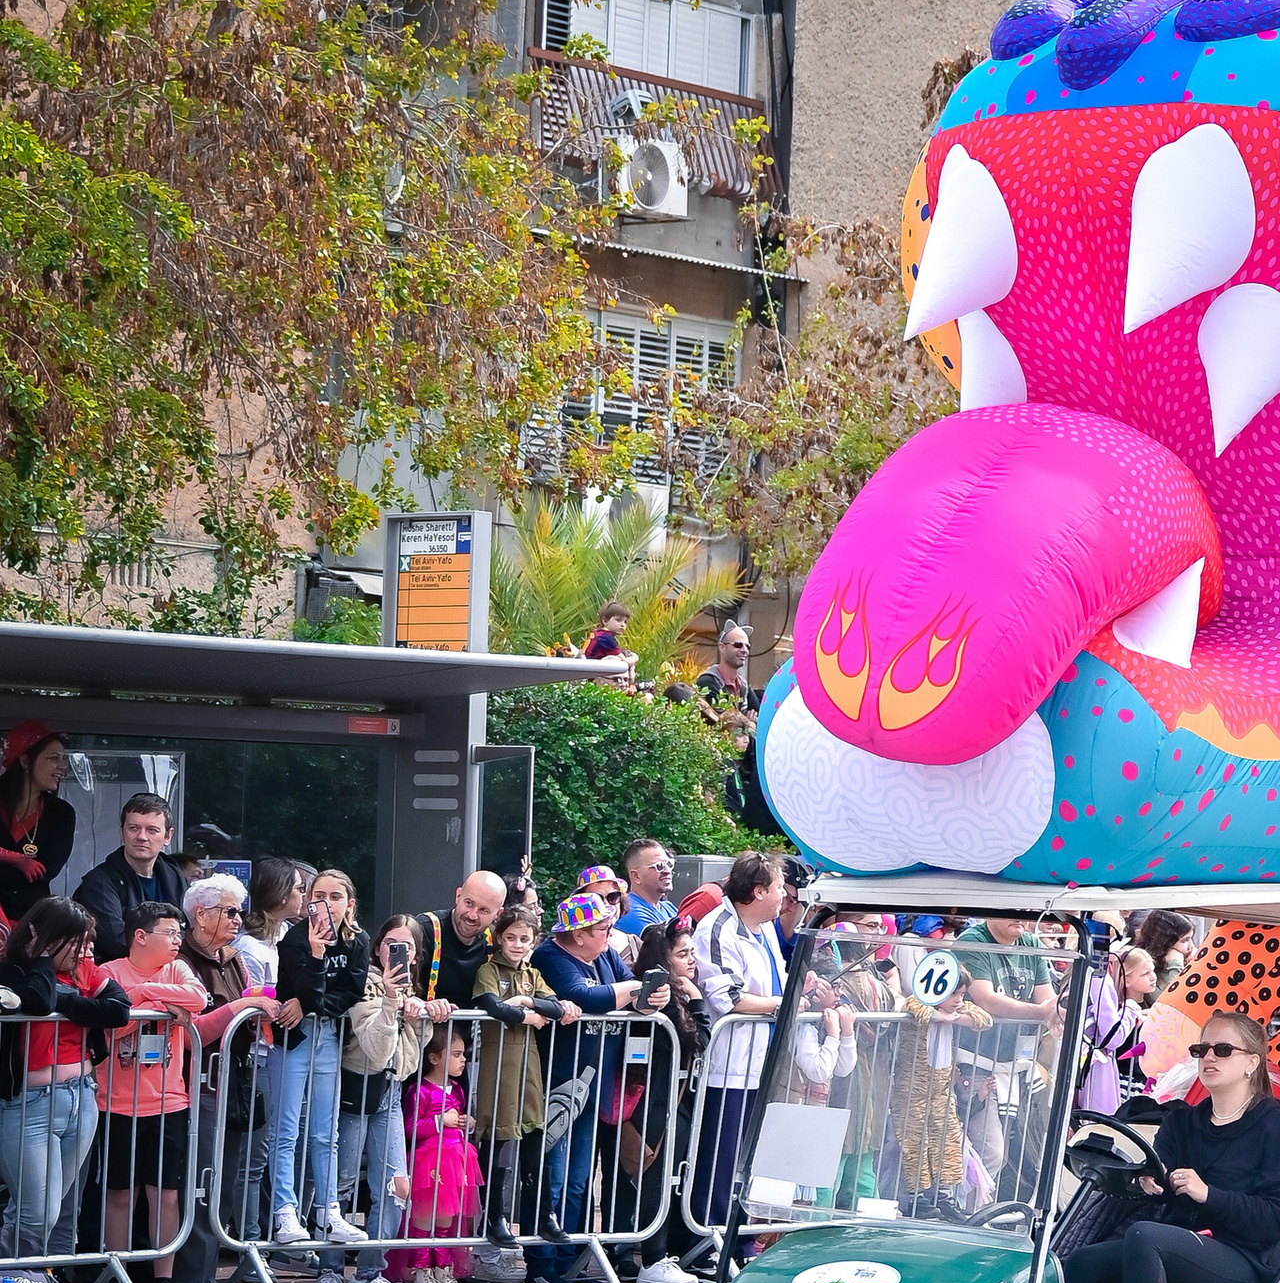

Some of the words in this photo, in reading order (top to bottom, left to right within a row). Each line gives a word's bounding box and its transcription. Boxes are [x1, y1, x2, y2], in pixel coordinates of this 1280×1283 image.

[401, 534, 422, 543] Keren
[423, 533, 455, 542] HaYesod
[428, 544, 448, 553] 36350
[411, 557, 421, 566] Tel
[411, 574, 421, 583] Tel
[919, 968, 950, 996] 16
